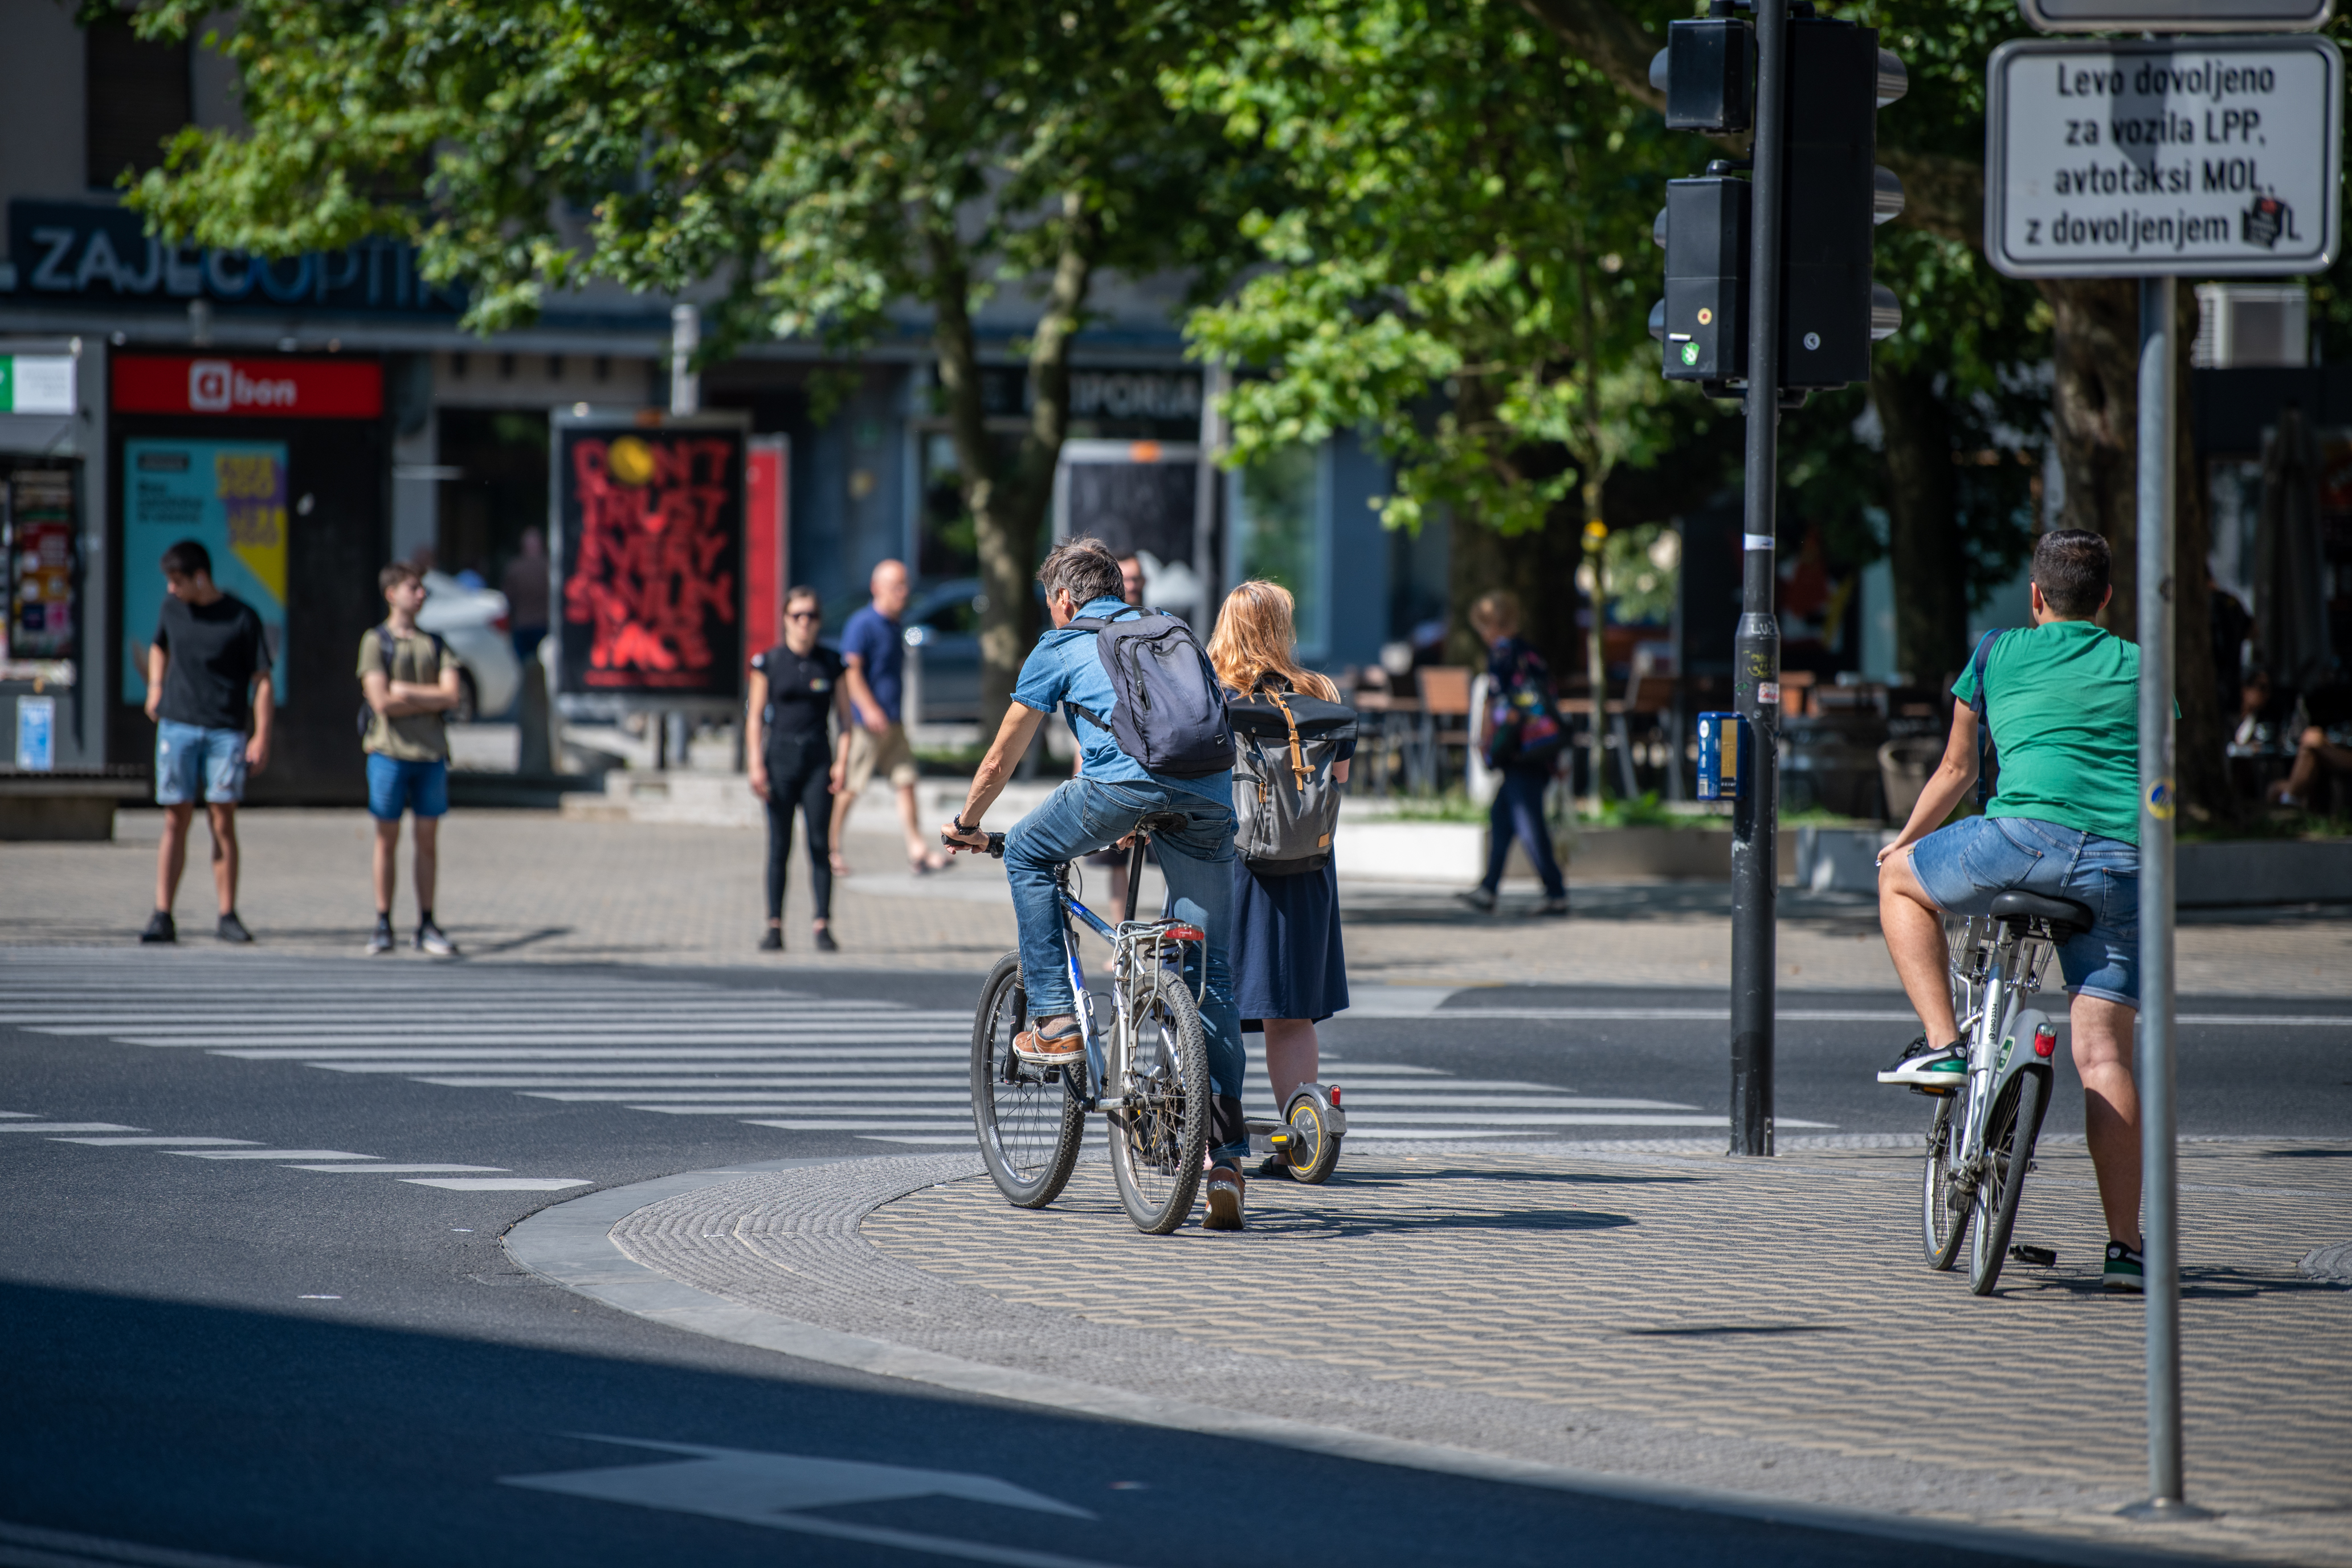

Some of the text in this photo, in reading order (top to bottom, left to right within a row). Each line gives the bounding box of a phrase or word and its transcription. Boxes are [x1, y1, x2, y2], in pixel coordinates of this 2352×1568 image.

[2057, 61, 2276, 102] Levo dovoljeno
[2065, 109, 2267, 147] za vozila LPP,
[2055, 158, 2275, 197] avtotaksi MOL,
[2026, 218, 2042, 245] z
[2052, 210, 2229, 253] dovoljenjem
